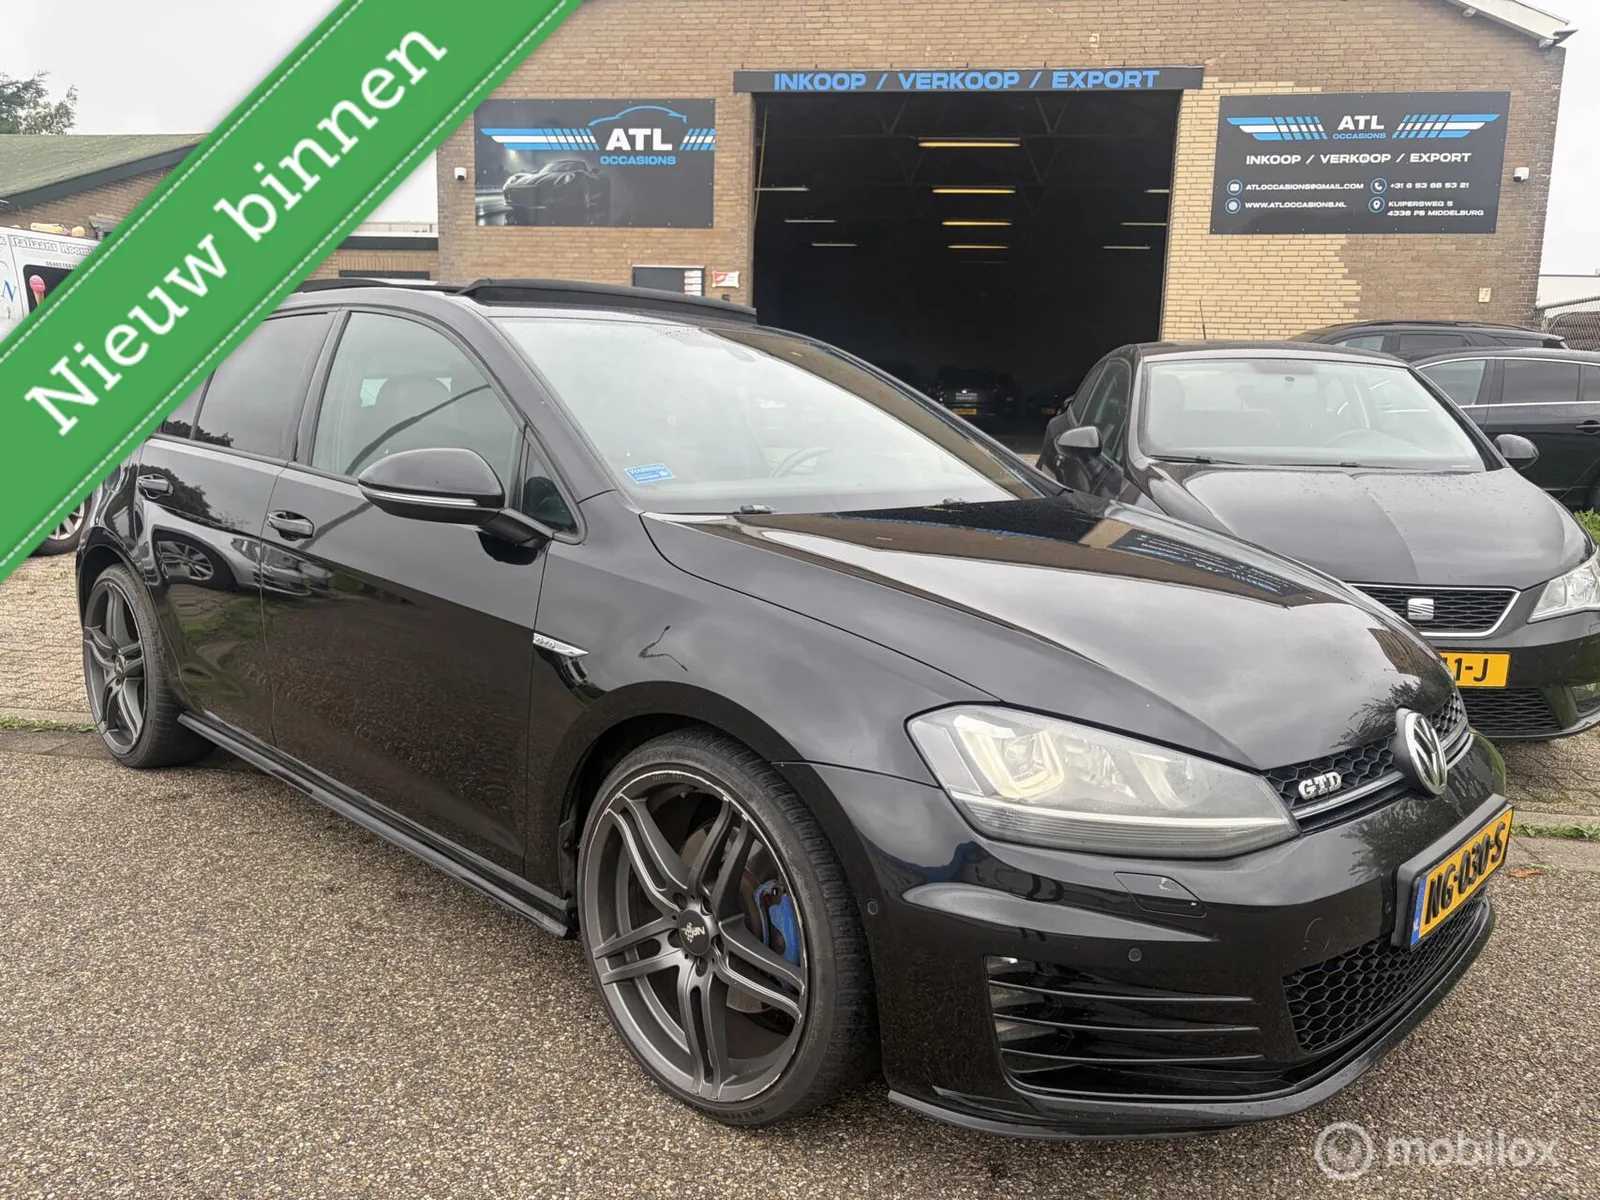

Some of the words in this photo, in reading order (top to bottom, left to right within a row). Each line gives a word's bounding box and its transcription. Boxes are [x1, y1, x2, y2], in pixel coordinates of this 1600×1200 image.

[773, 72, 867, 91] INKOOP
[899, 71, 1020, 91] VERKOOP
[1051, 69, 1161, 90] EXPORT
[1336, 115, 1385, 131] ATL
[604, 127, 673, 151] ATL
[1332, 131, 1387, 140] OCCASIONS
[599, 154, 677, 166] OCCASIONS
[1246, 154, 1302, 165] INKOOP
[1320, 152, 1392, 164] VERKOOP
[1409, 152, 1472, 163] EXPORT
[1244, 201, 1347, 209] WWW.ATLOCCASIONS.NL
[1427, 209, 1485, 217] MIDDELBURG
[1298, 771, 1342, 800] GTD
[1424, 820, 1506, 925] NG-030-S
